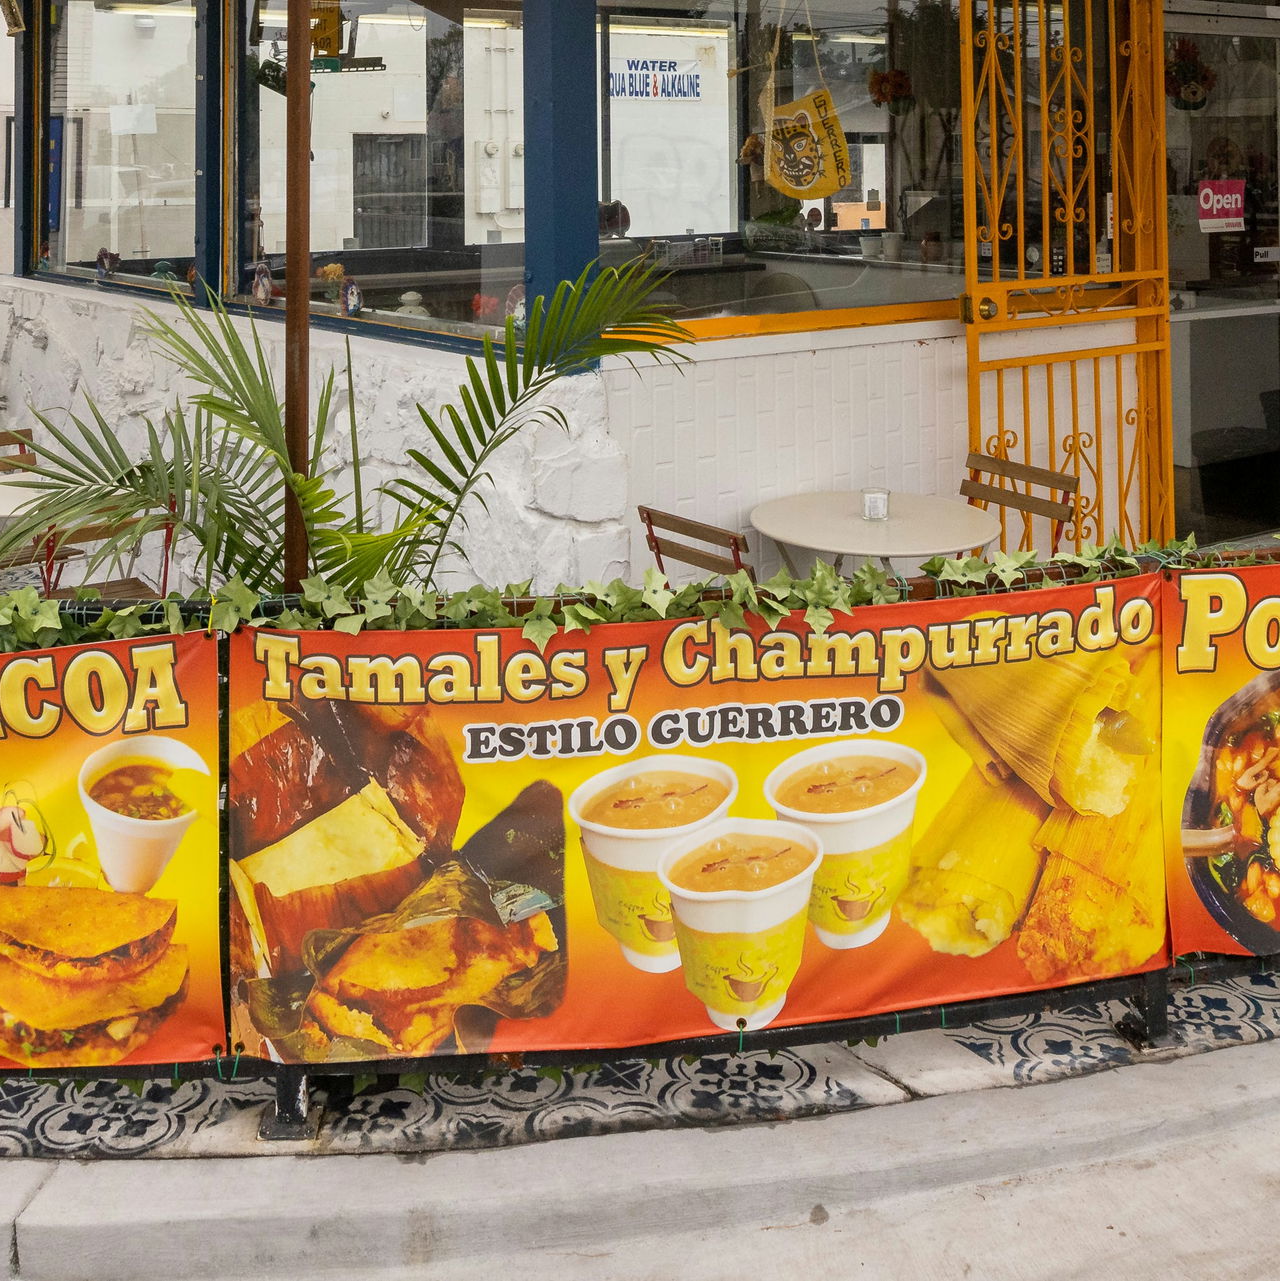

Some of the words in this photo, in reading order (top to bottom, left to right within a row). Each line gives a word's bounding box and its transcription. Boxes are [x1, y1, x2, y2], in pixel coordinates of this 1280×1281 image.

[627, 60, 677, 72] WATER
[629, 73, 650, 97] BLUE
[652, 74, 658, 97] &
[661, 74, 700, 97] ALKALINE
[1200, 188, 1242, 215] Open
[255, 628, 588, 706] Tamales
[602, 642, 648, 713] y
[661, 584, 1156, 696] Champurrado
[466, 716, 637, 763] ESTILO
[652, 695, 903, 746] GUERRERO
